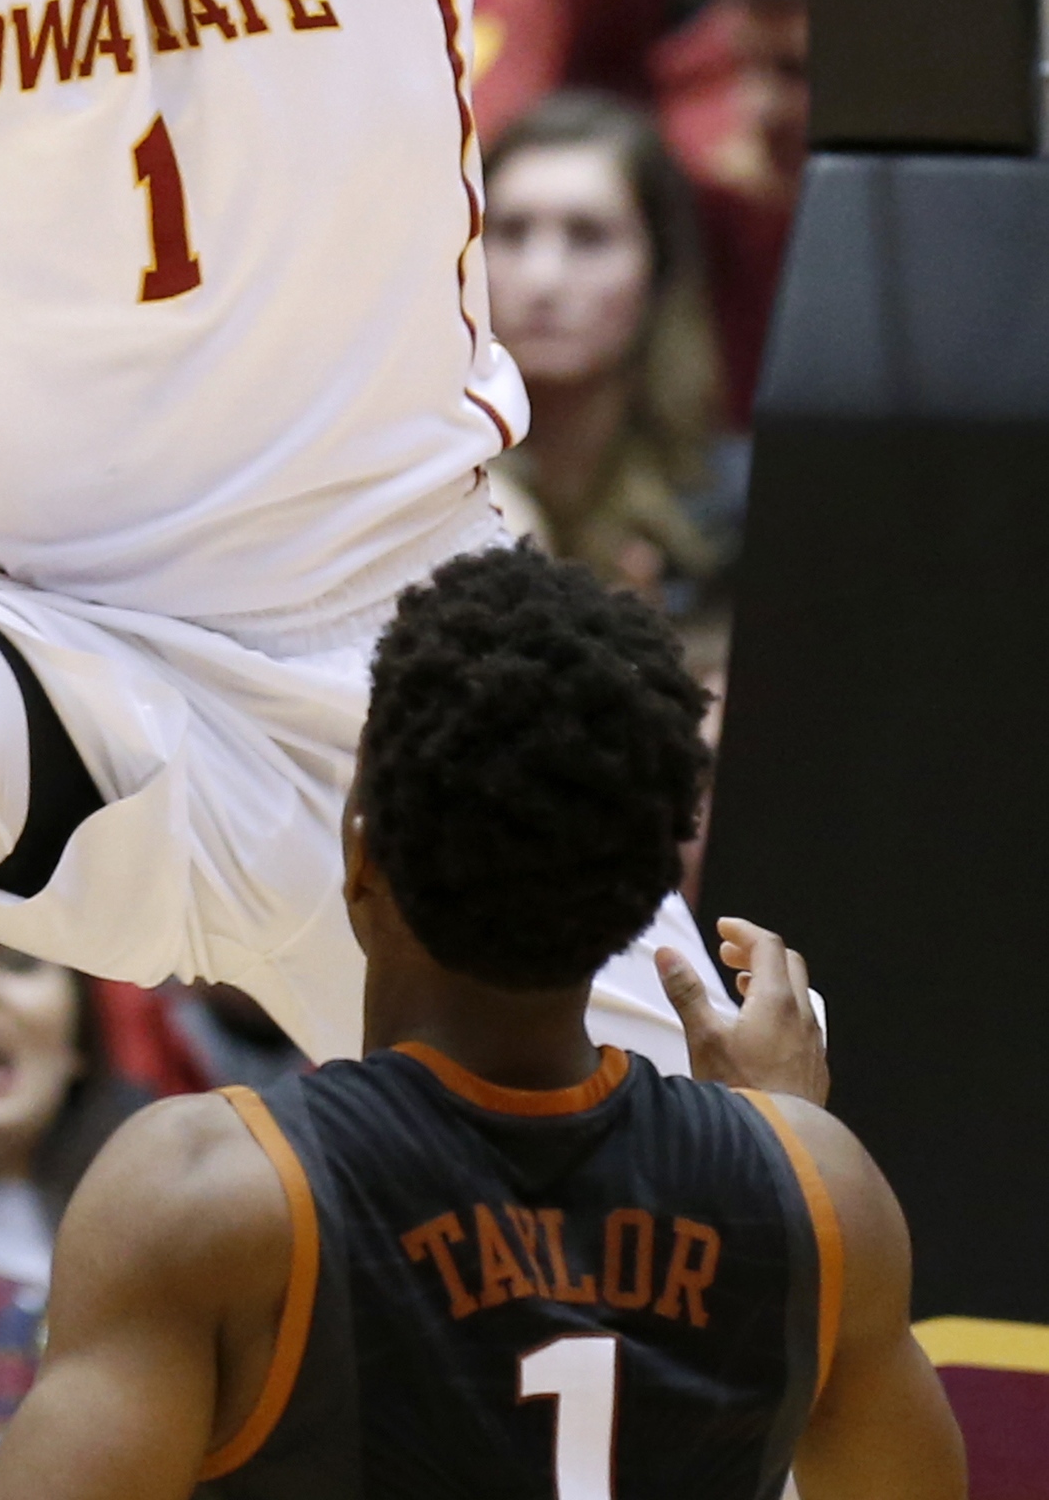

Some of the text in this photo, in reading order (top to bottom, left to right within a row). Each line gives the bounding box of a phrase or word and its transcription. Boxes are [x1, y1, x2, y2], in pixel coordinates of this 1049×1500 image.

[131, 110, 203, 304] 1
[400, 1202, 722, 1329] TAYLOR
[517, 1331, 623, 1500] 1
